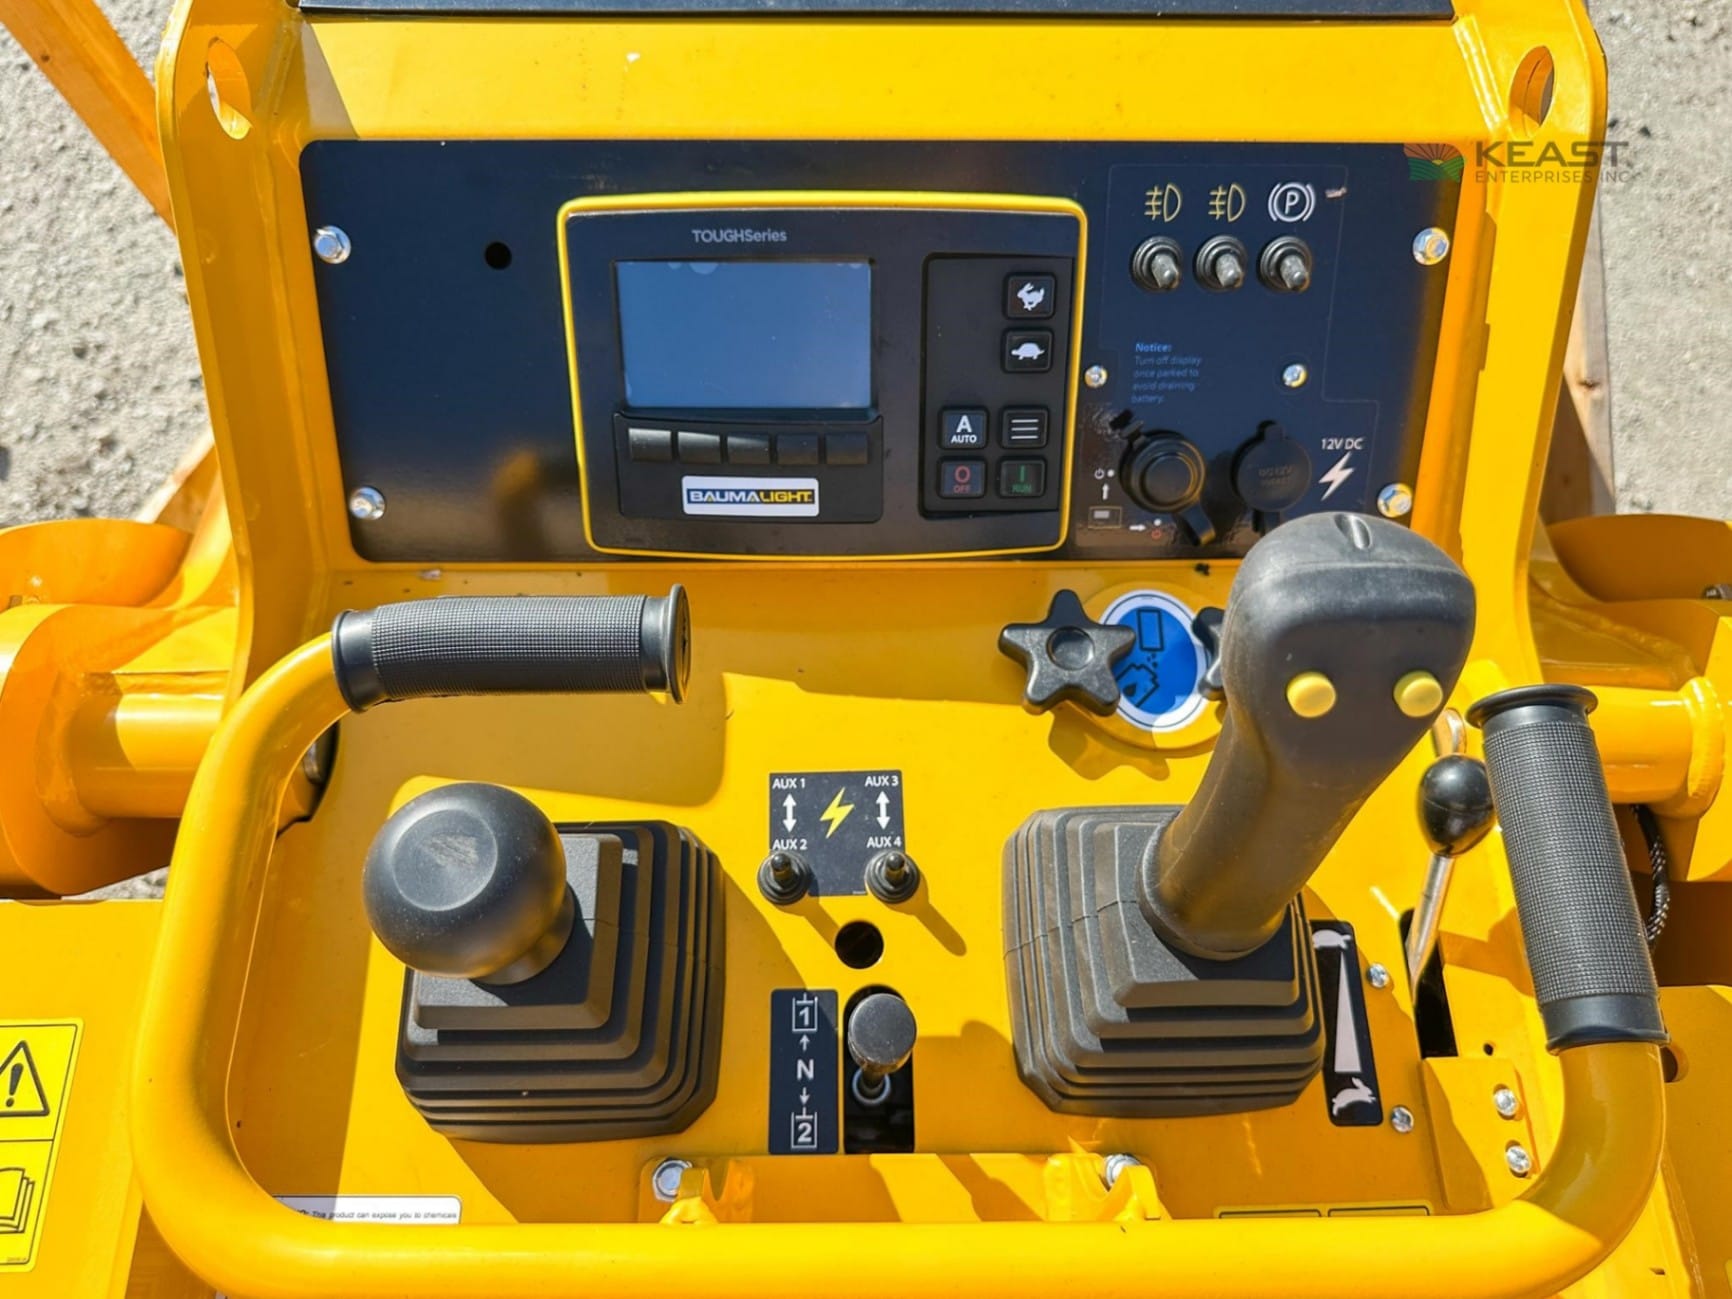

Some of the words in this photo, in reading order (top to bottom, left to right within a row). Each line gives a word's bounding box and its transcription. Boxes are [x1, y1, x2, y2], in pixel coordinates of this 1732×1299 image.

[691, 228, 787, 243] TOUGHSeries
[1135, 342, 1172, 352] Notice:
[1170, 356, 1202, 368] display
[1156, 368, 1188, 380] parked
[956, 414, 972, 433] A
[950, 434, 977, 444] AUTO
[1321, 438, 1344, 450] 12V
[1344, 437, 1364, 450] DC
[953, 484, 971, 494] OFF
[1012, 484, 1032, 494] RUN
[772, 778, 797, 789] AUX
[800, 777, 806, 788] 1
[864, 775, 890, 787] AUX
[892, 775, 899, 786] 3
[772, 839, 798, 850] AUX
[800, 838, 808, 850] 2
[866, 836, 892, 848] AUX
[894, 836, 902, 847] 4
[799, 1006, 810, 1027] 1
[796, 1058, 814, 1080] N
[797, 1122, 812, 1143] 2
[372, 1212, 396, 1220] expose
[399, 1212, 411, 1220] you
